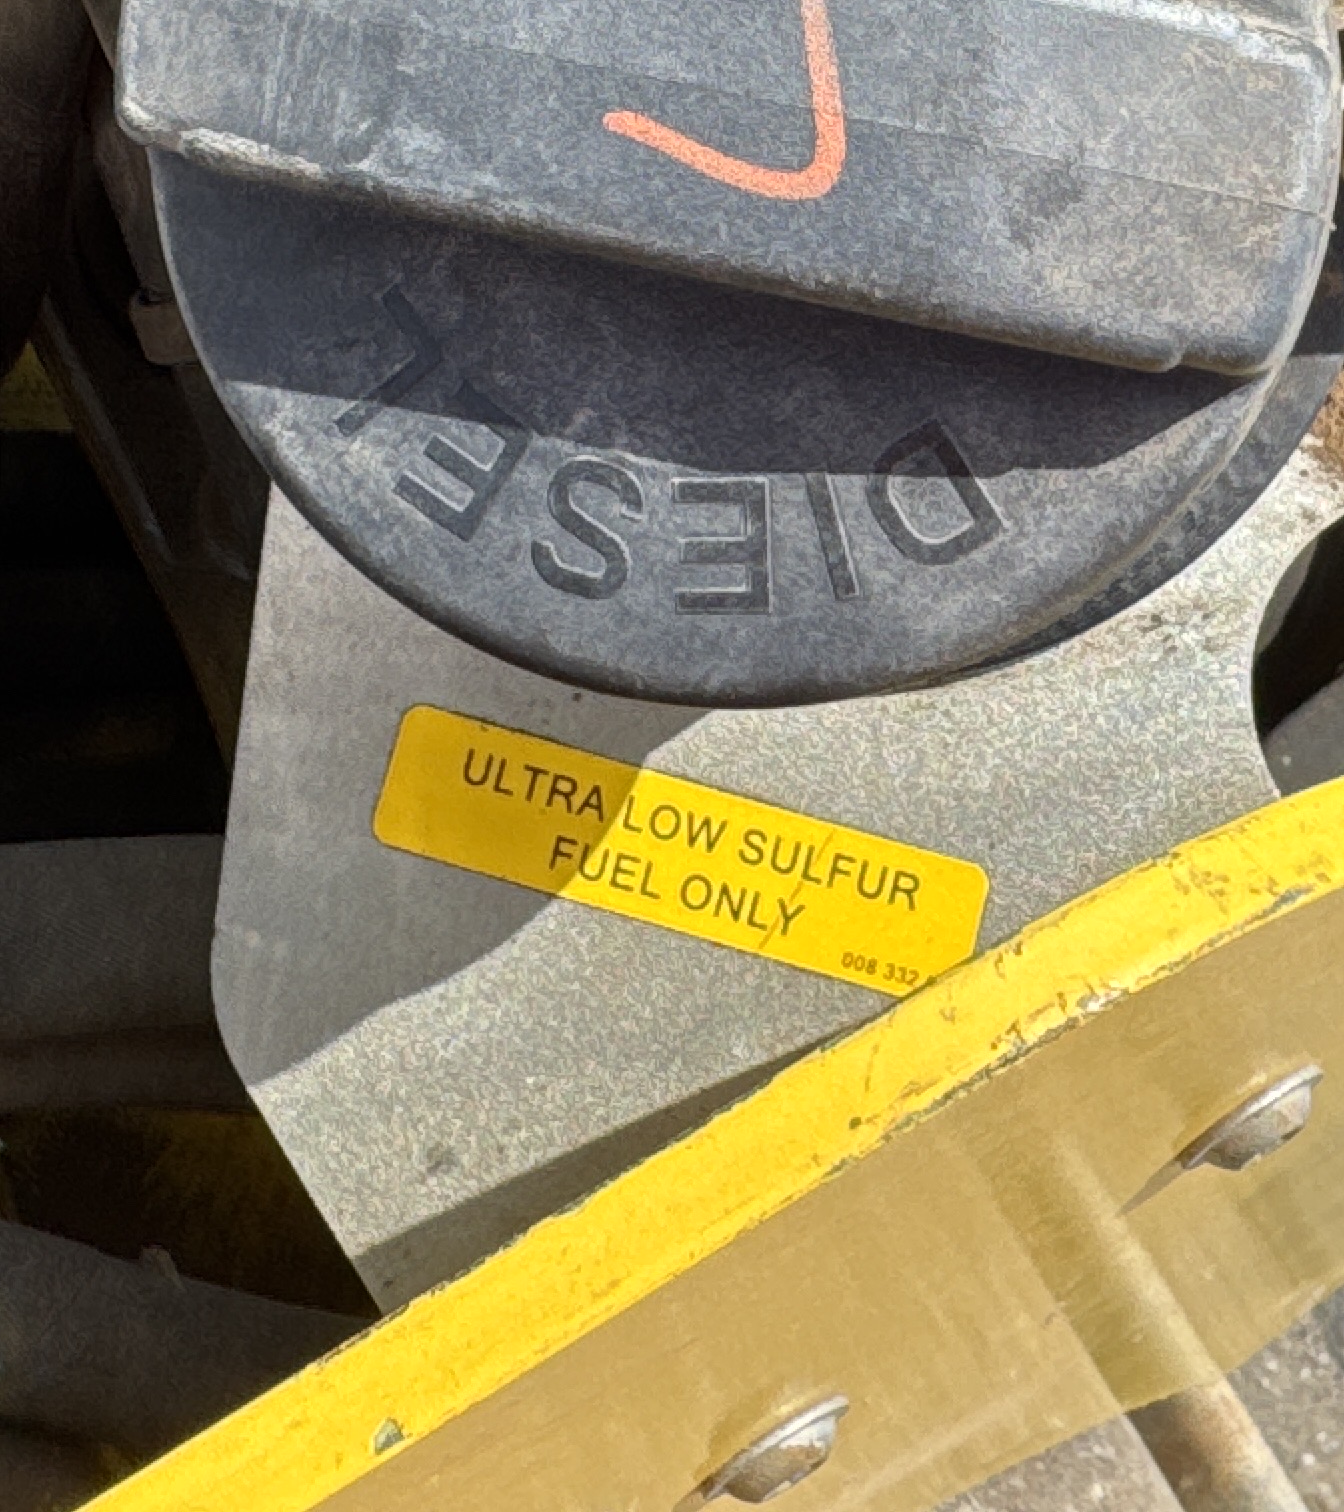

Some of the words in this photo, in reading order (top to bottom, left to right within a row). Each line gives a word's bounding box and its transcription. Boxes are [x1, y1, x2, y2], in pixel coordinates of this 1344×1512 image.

[333, 285, 1011, 616] DIESEL
[463, 747, 604, 823] ULTRA
[622, 794, 728, 854] LOW
[738, 828, 922, 912] SULFUR
[548, 834, 661, 900] FUEL
[680, 874, 806, 936] ONLY
[841, 952, 878, 975] 008
